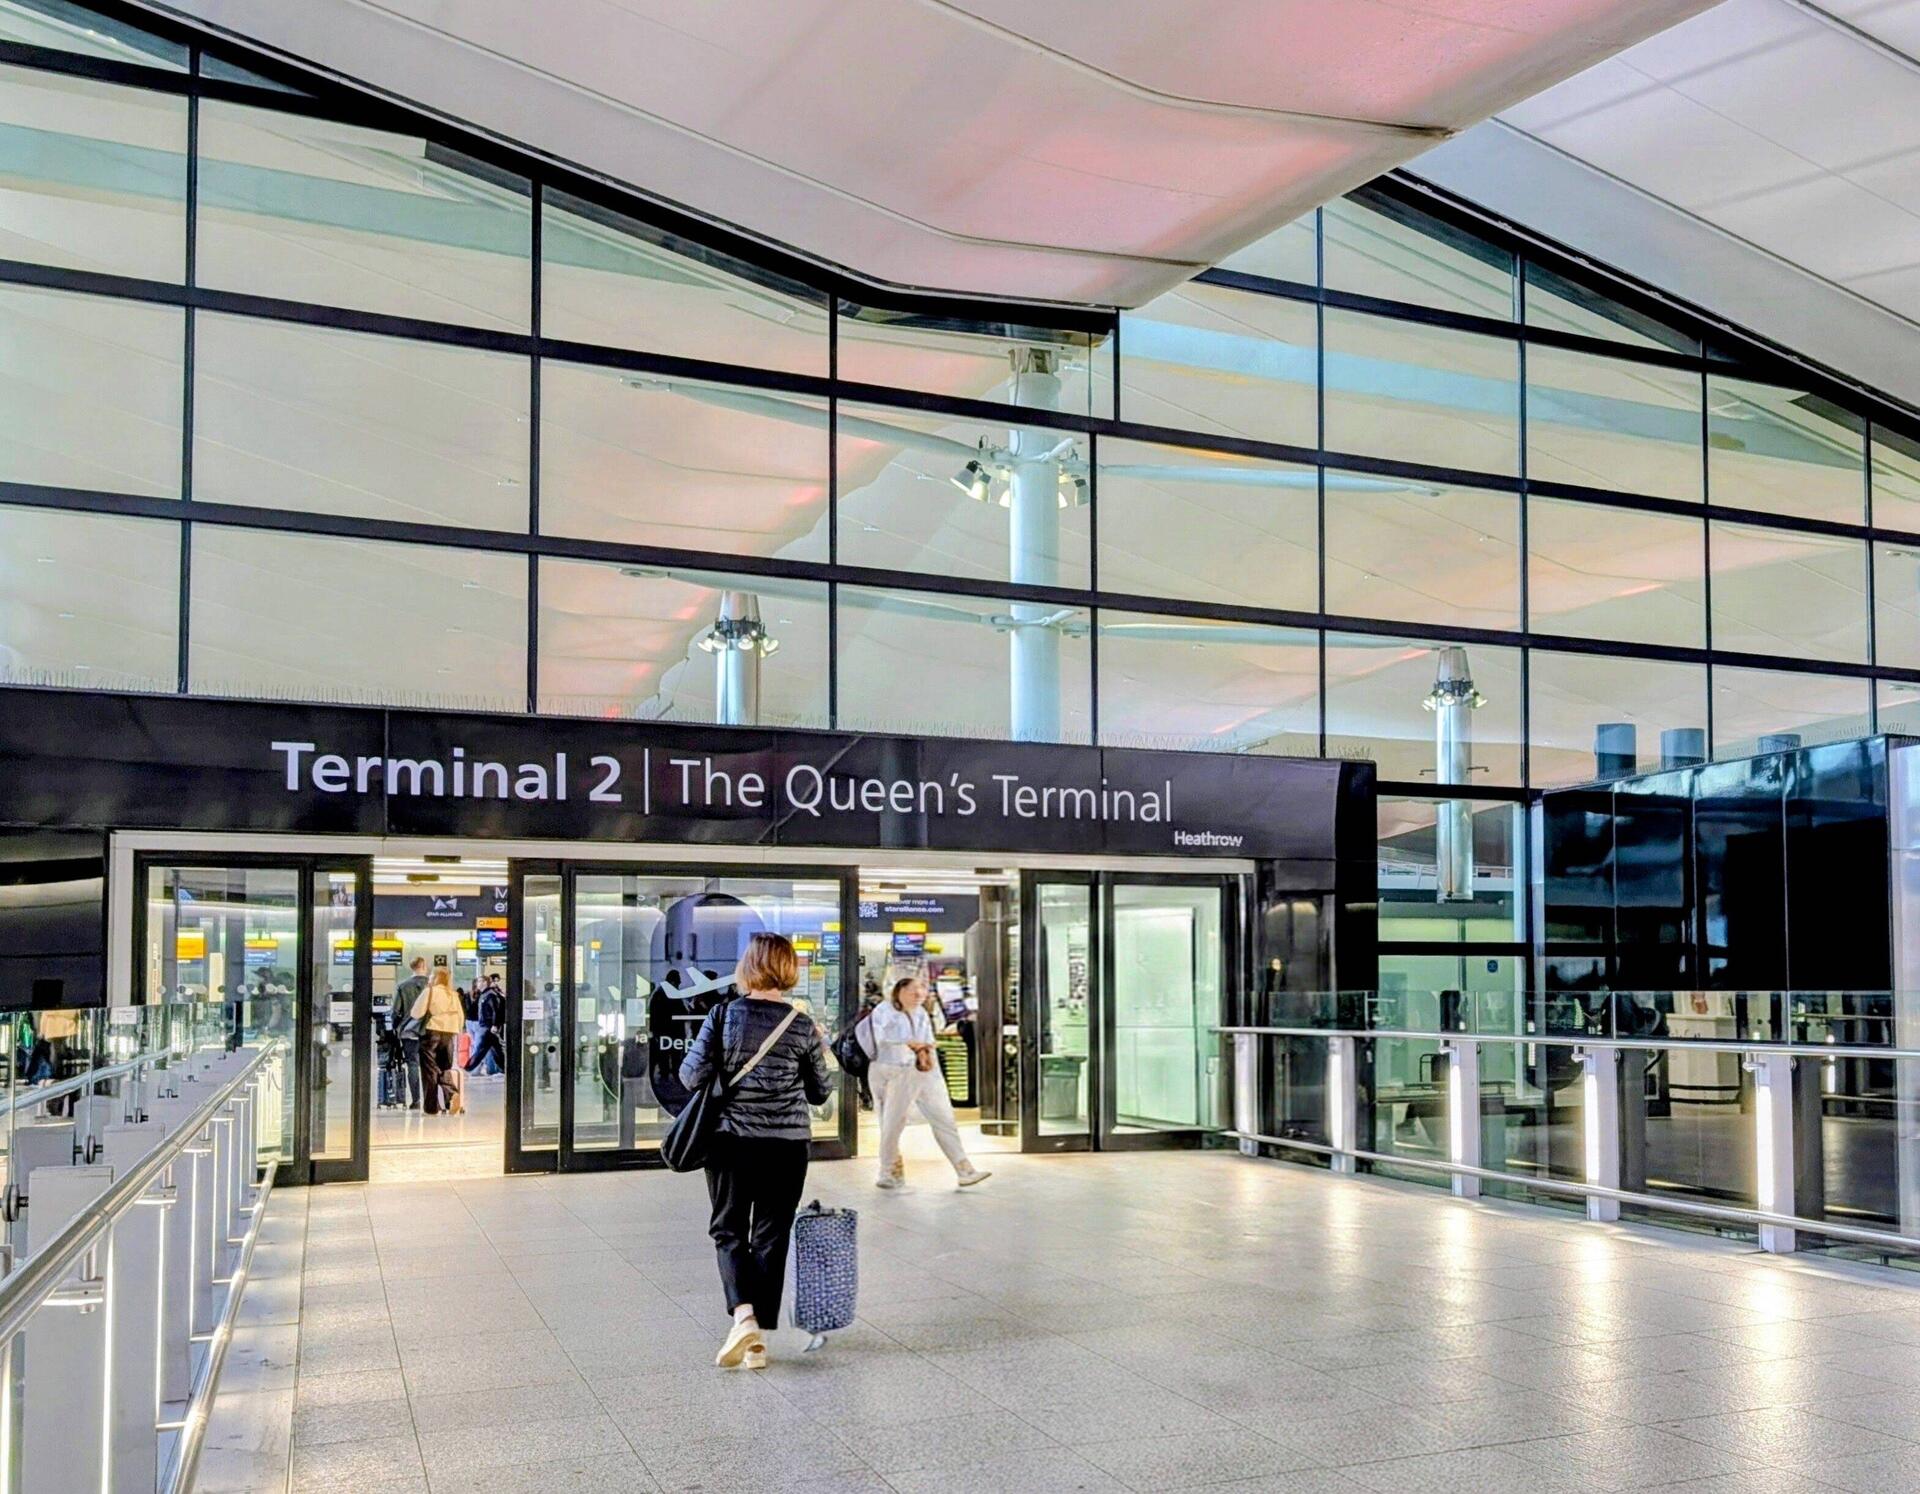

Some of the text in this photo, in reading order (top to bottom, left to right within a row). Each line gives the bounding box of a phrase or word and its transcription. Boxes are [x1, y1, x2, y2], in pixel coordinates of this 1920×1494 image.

[271, 741, 1171, 822] Terminal 2 The Queen's Terminal
[1174, 830, 1243, 847] Heathrow
